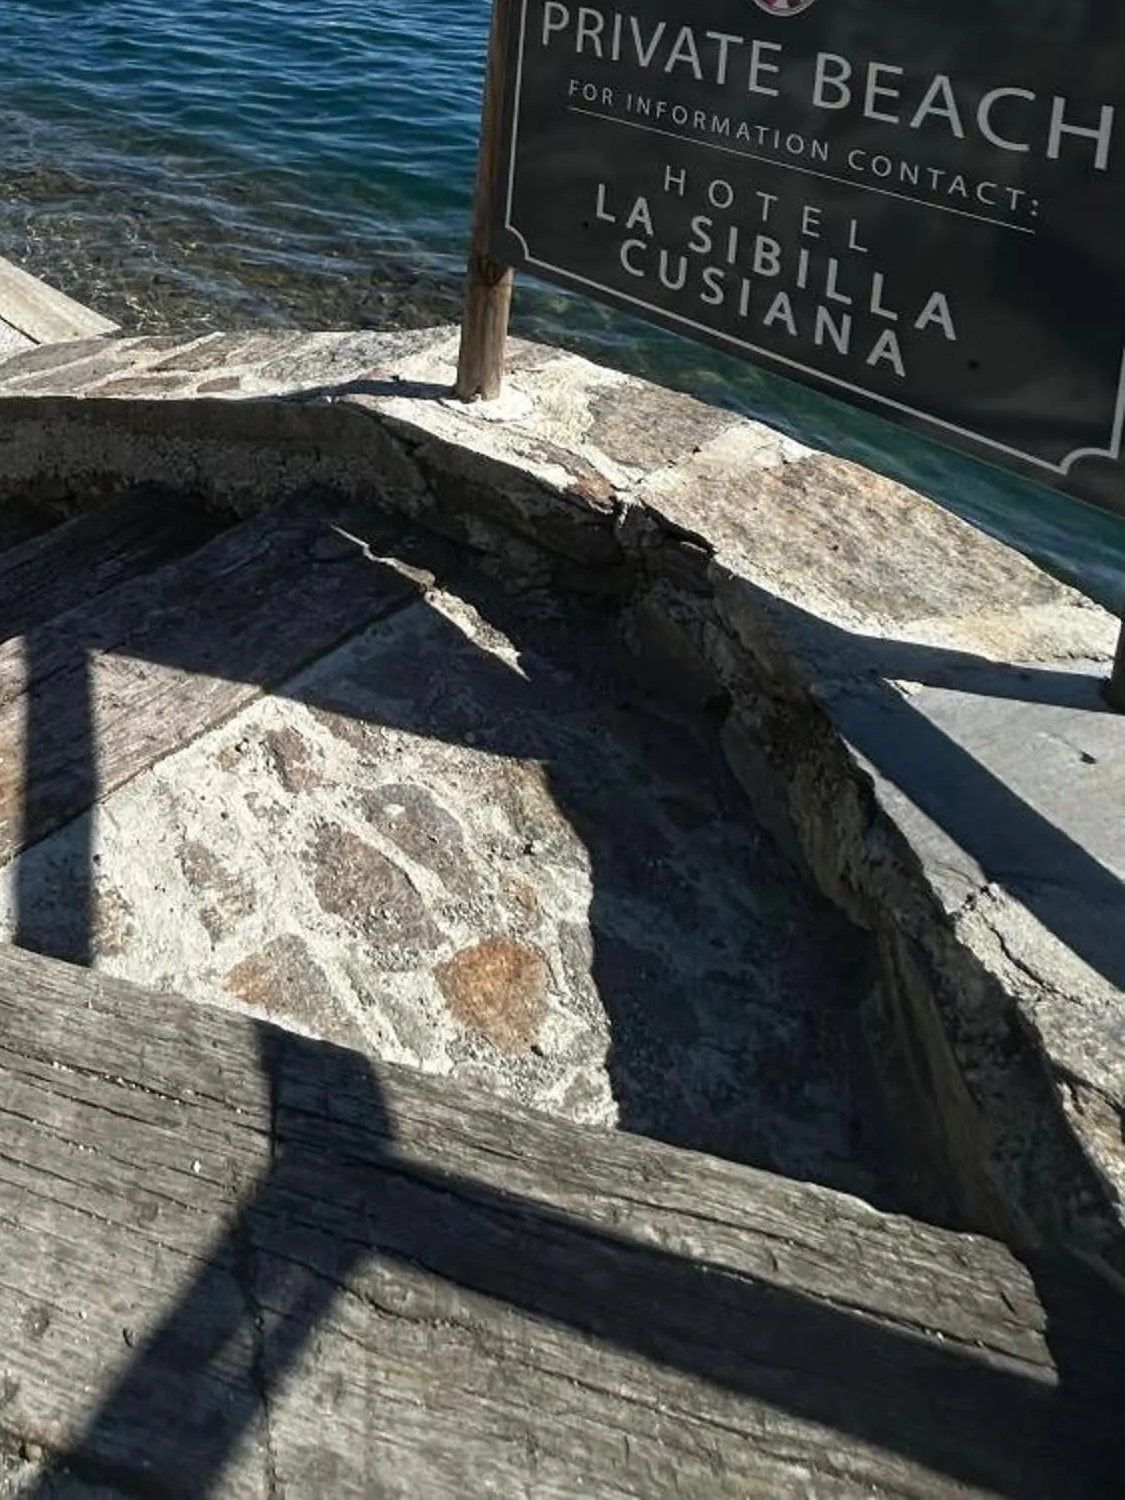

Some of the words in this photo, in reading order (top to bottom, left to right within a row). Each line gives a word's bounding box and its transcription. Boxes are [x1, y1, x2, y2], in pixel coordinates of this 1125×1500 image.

[541, 1, 782, 97] PRIVATE
[811, 51, 1115, 170] BEACH
[568, 78, 615, 106] FOR
[626, 93, 831, 162] INFORMATION
[847, 149, 1040, 217] CONTACT:
[595, 184, 654, 236] LA
[688, 214, 958, 342] SIBILLA
[663, 164, 869, 253] HOTEL
[619, 238, 907, 378] CUSIANA
